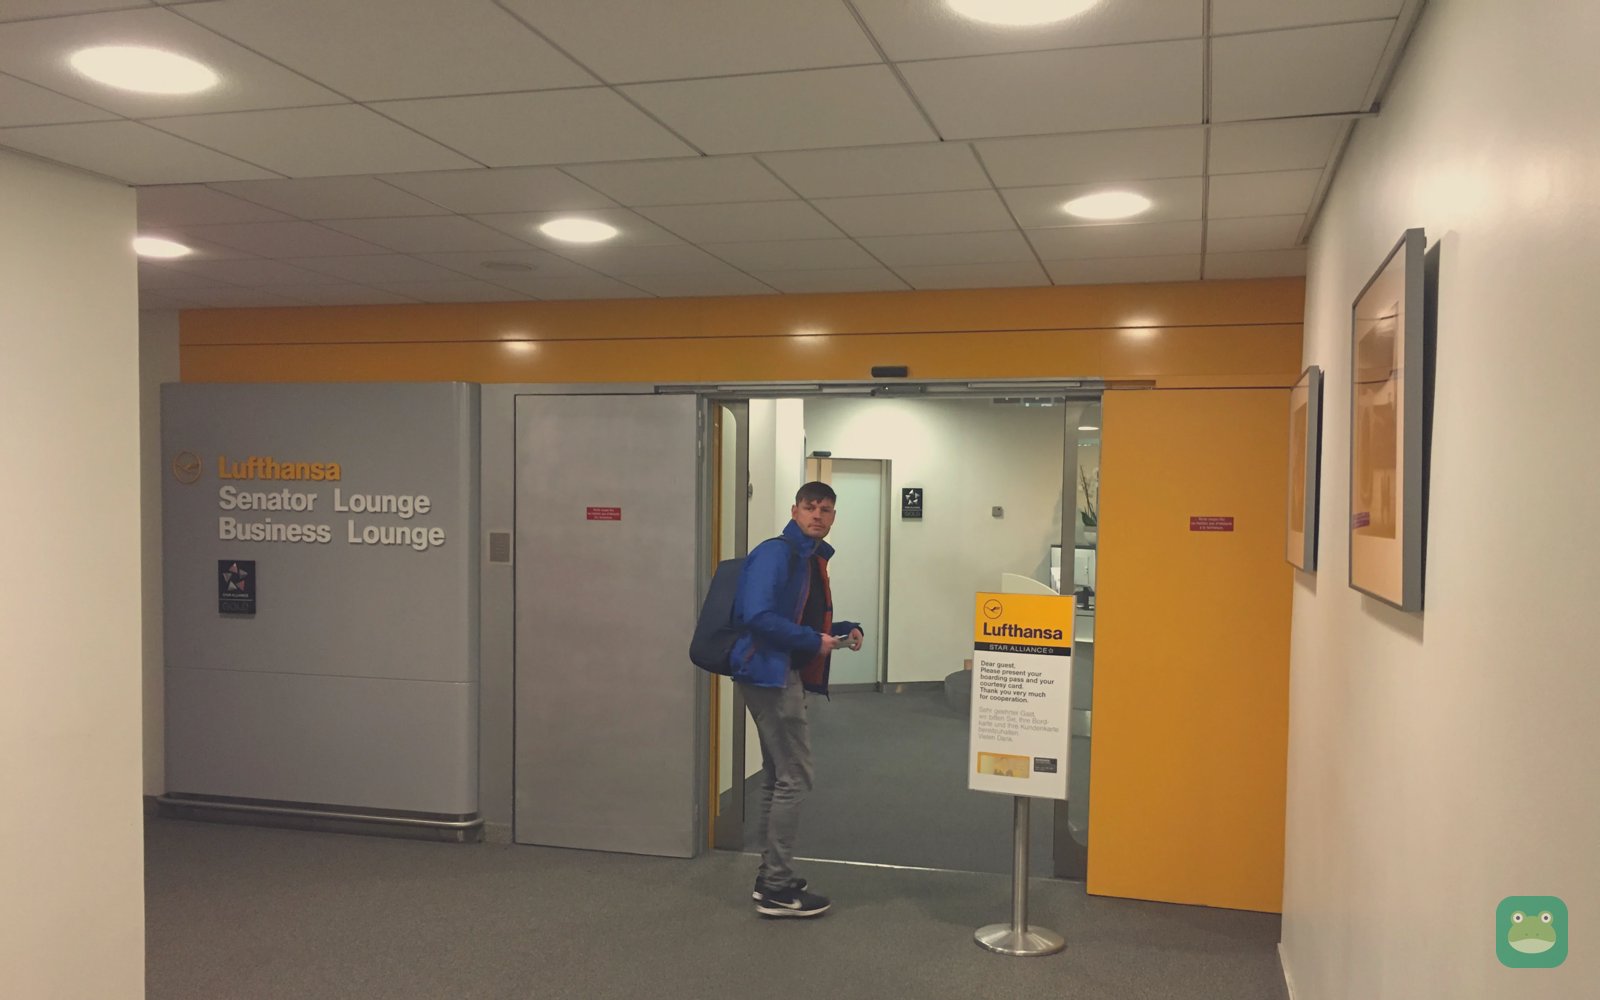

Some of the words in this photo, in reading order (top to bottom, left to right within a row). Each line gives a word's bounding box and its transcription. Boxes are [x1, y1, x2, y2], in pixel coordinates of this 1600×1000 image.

[218, 456, 341, 481] Lufthansa
[219, 486, 317, 511] Senator
[334, 488, 431, 519] Lounge
[219, 517, 331, 543] Business
[348, 520, 446, 551] Lounge
[983, 622, 1063, 640] Lufthansa
[1010, 645, 1048, 654] ALLIANCE
[980, 674, 1007, 682] boarding
[980, 681, 1007, 689] courtesy
